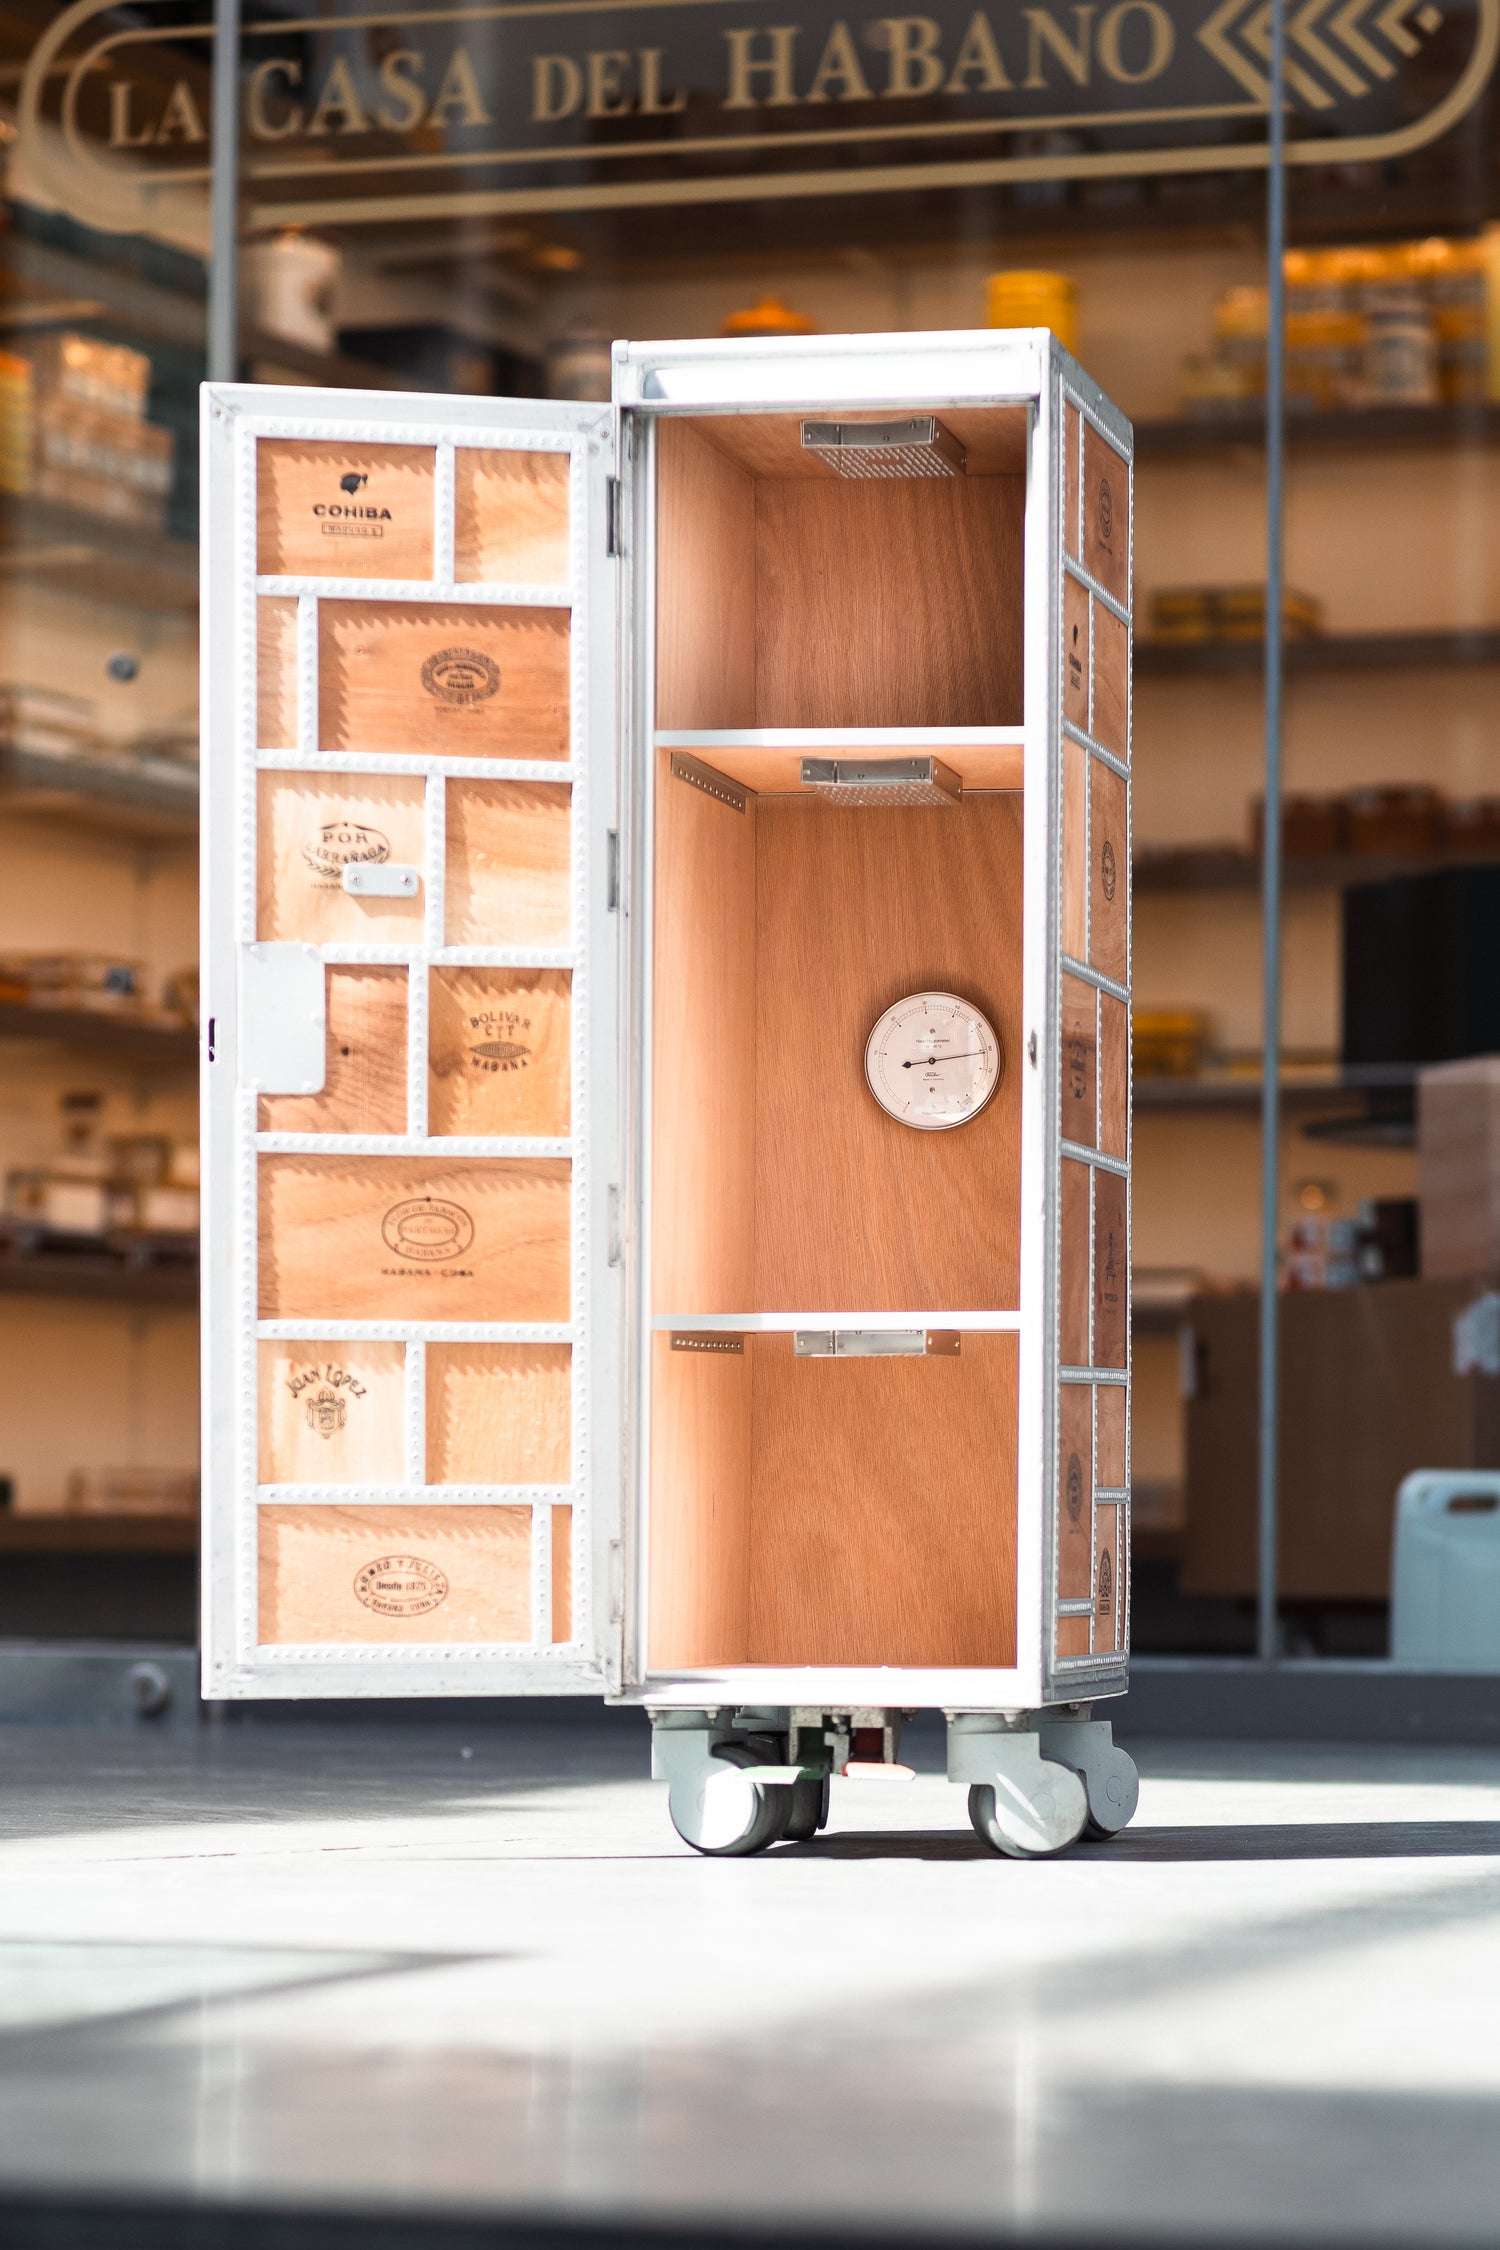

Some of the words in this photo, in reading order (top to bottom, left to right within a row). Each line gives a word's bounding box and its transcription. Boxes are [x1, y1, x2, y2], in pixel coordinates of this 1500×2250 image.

[109, 80, 208, 147] LA
[247, 48, 491, 140] CASA
[532, 48, 687, 122] DEL
[722, 2, 1175, 109] HABANO
[312, 503, 392, 520] COHIBA
[322, 831, 368, 843] POR
[470, 1010, 532, 1030] BOLIVAR
